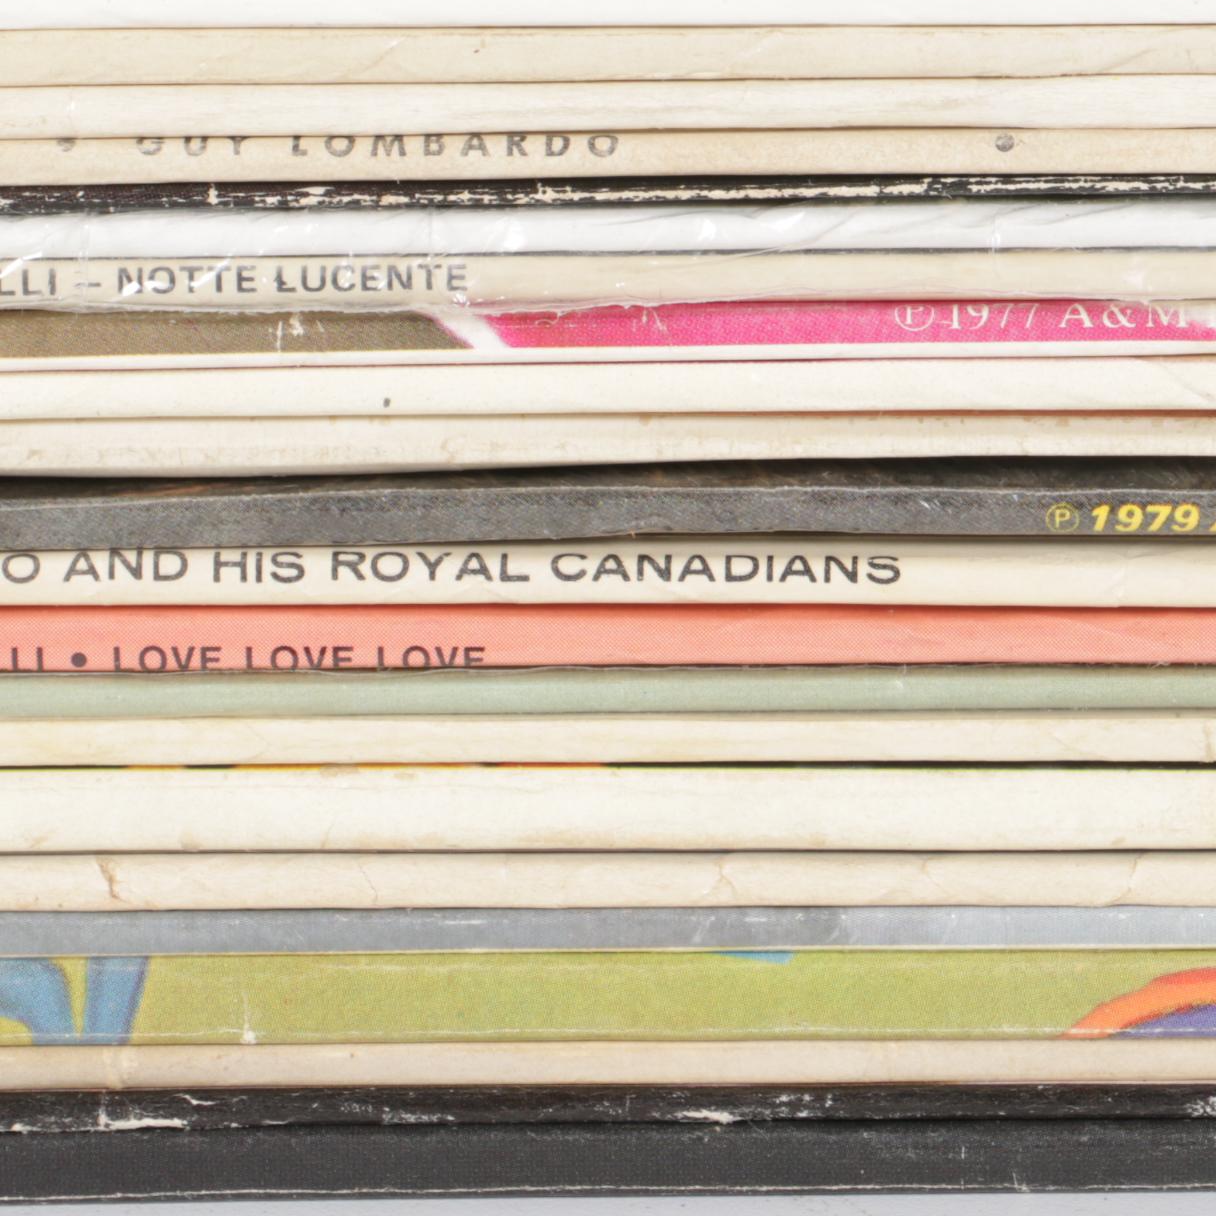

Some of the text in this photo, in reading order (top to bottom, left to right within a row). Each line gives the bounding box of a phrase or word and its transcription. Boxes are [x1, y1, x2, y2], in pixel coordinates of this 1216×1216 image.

[290, 134, 621, 158] LOMBARDO
[117, 266, 258, 296] NOTTE
[274, 262, 469, 294] LUCENTE
[1059, 302, 1188, 330] A&M
[1090, 505, 1199, 532] 1979
[2, 551, 903, 585] O AND HIS ROYAL CANADIANS
[113, 646, 222, 671] LOVE
[246, 646, 354, 670] LOVE
[377, 646, 487, 668] LOVE
